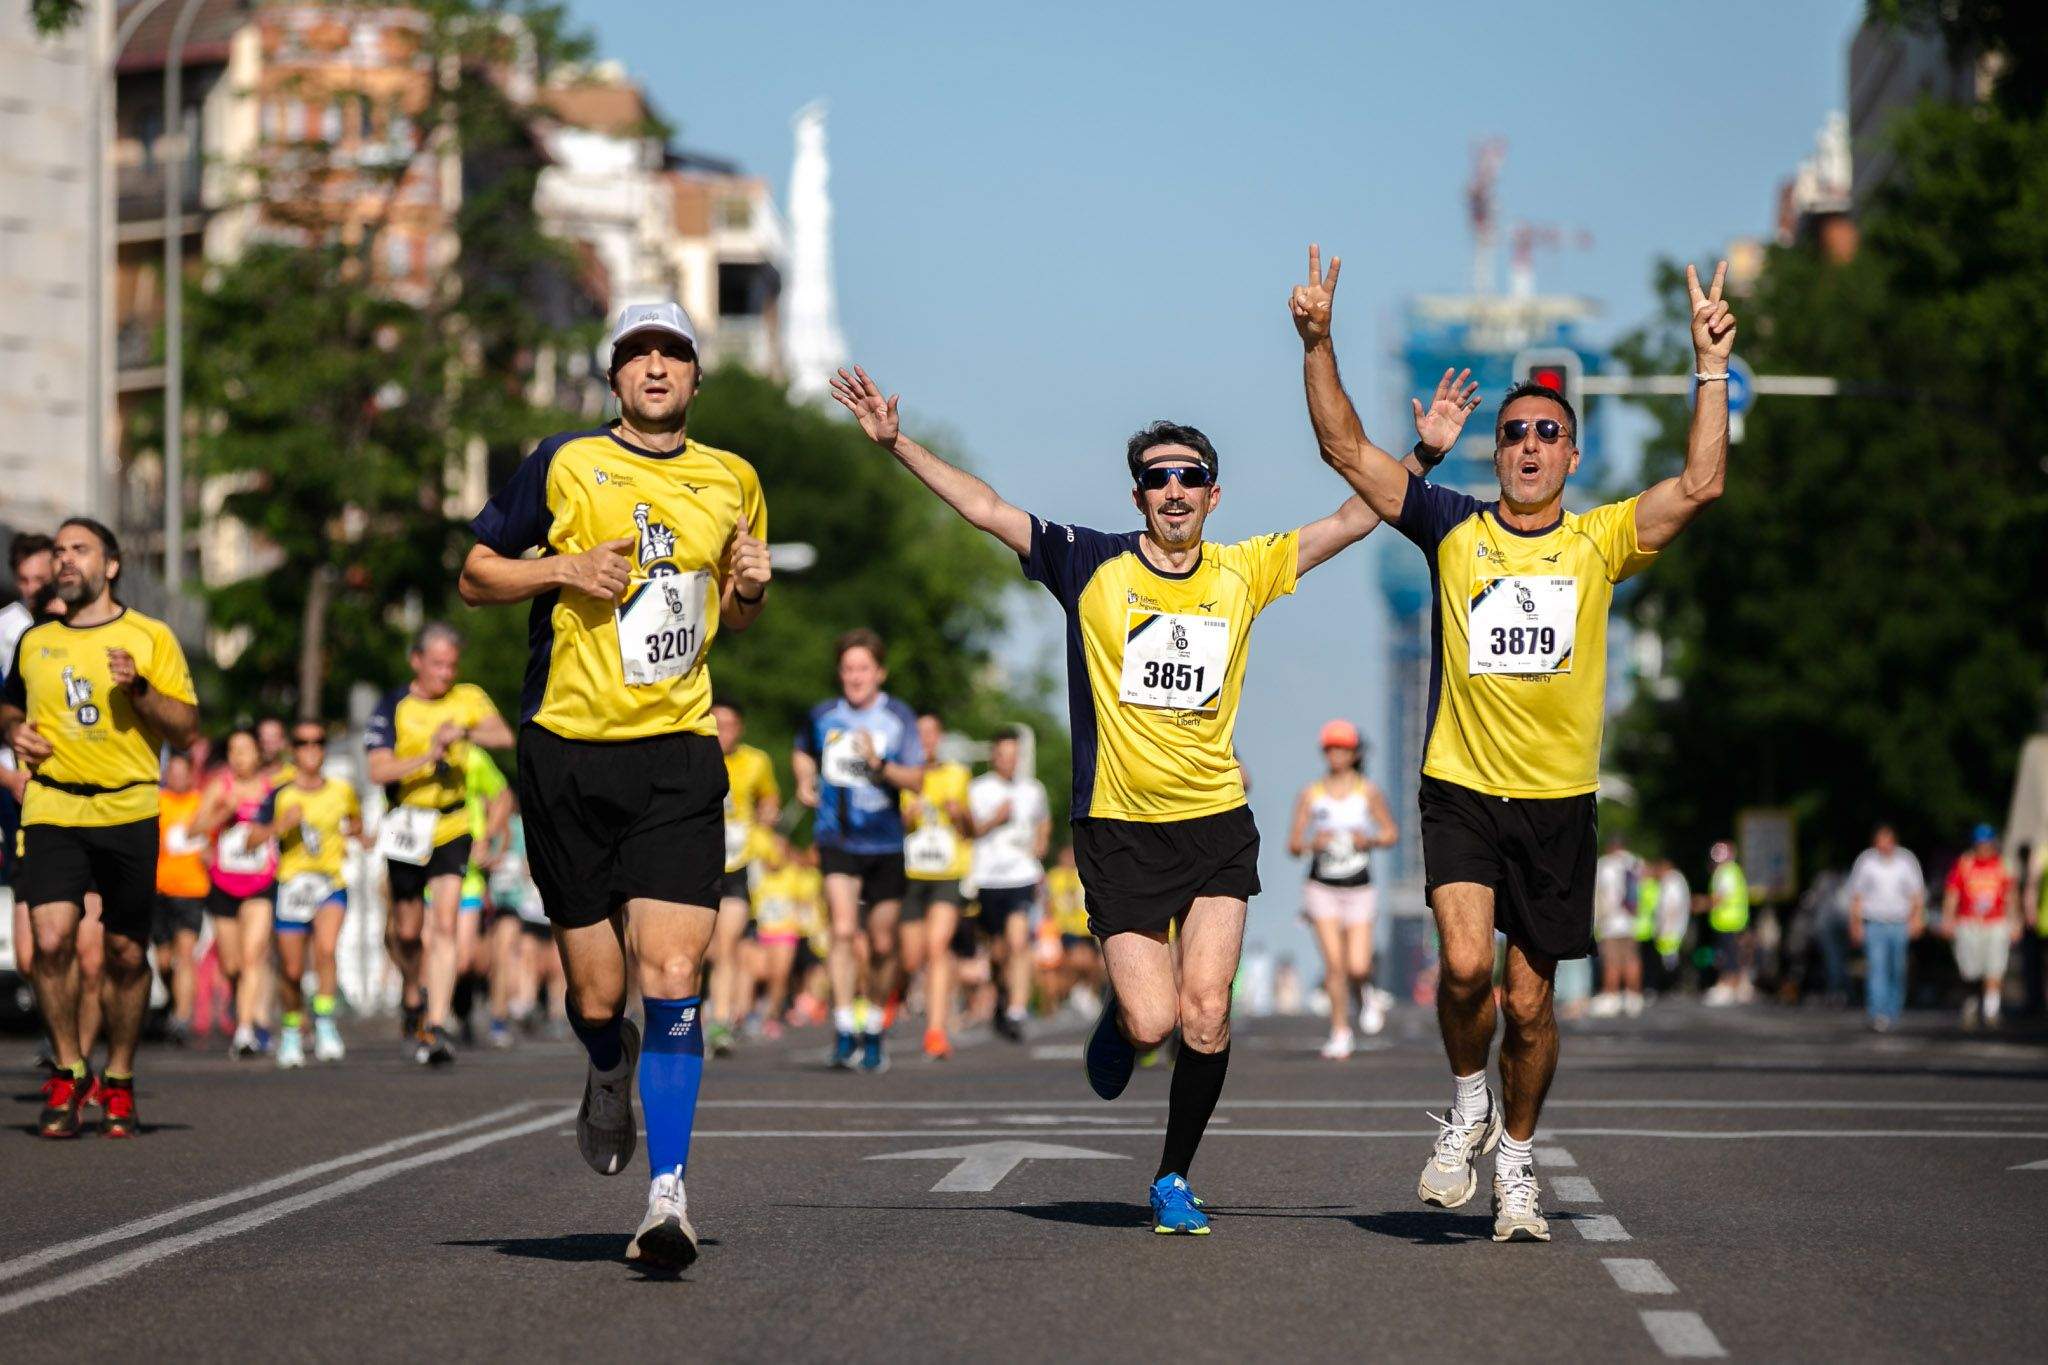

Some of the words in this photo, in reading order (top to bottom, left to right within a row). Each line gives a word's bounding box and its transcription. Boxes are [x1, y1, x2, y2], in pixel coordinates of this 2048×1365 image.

[645, 623, 696, 664] 3201
[1490, 627, 1556, 655] 3879
[1143, 661, 1205, 693] 3851
[1176, 717, 1201, 727] Liberty
